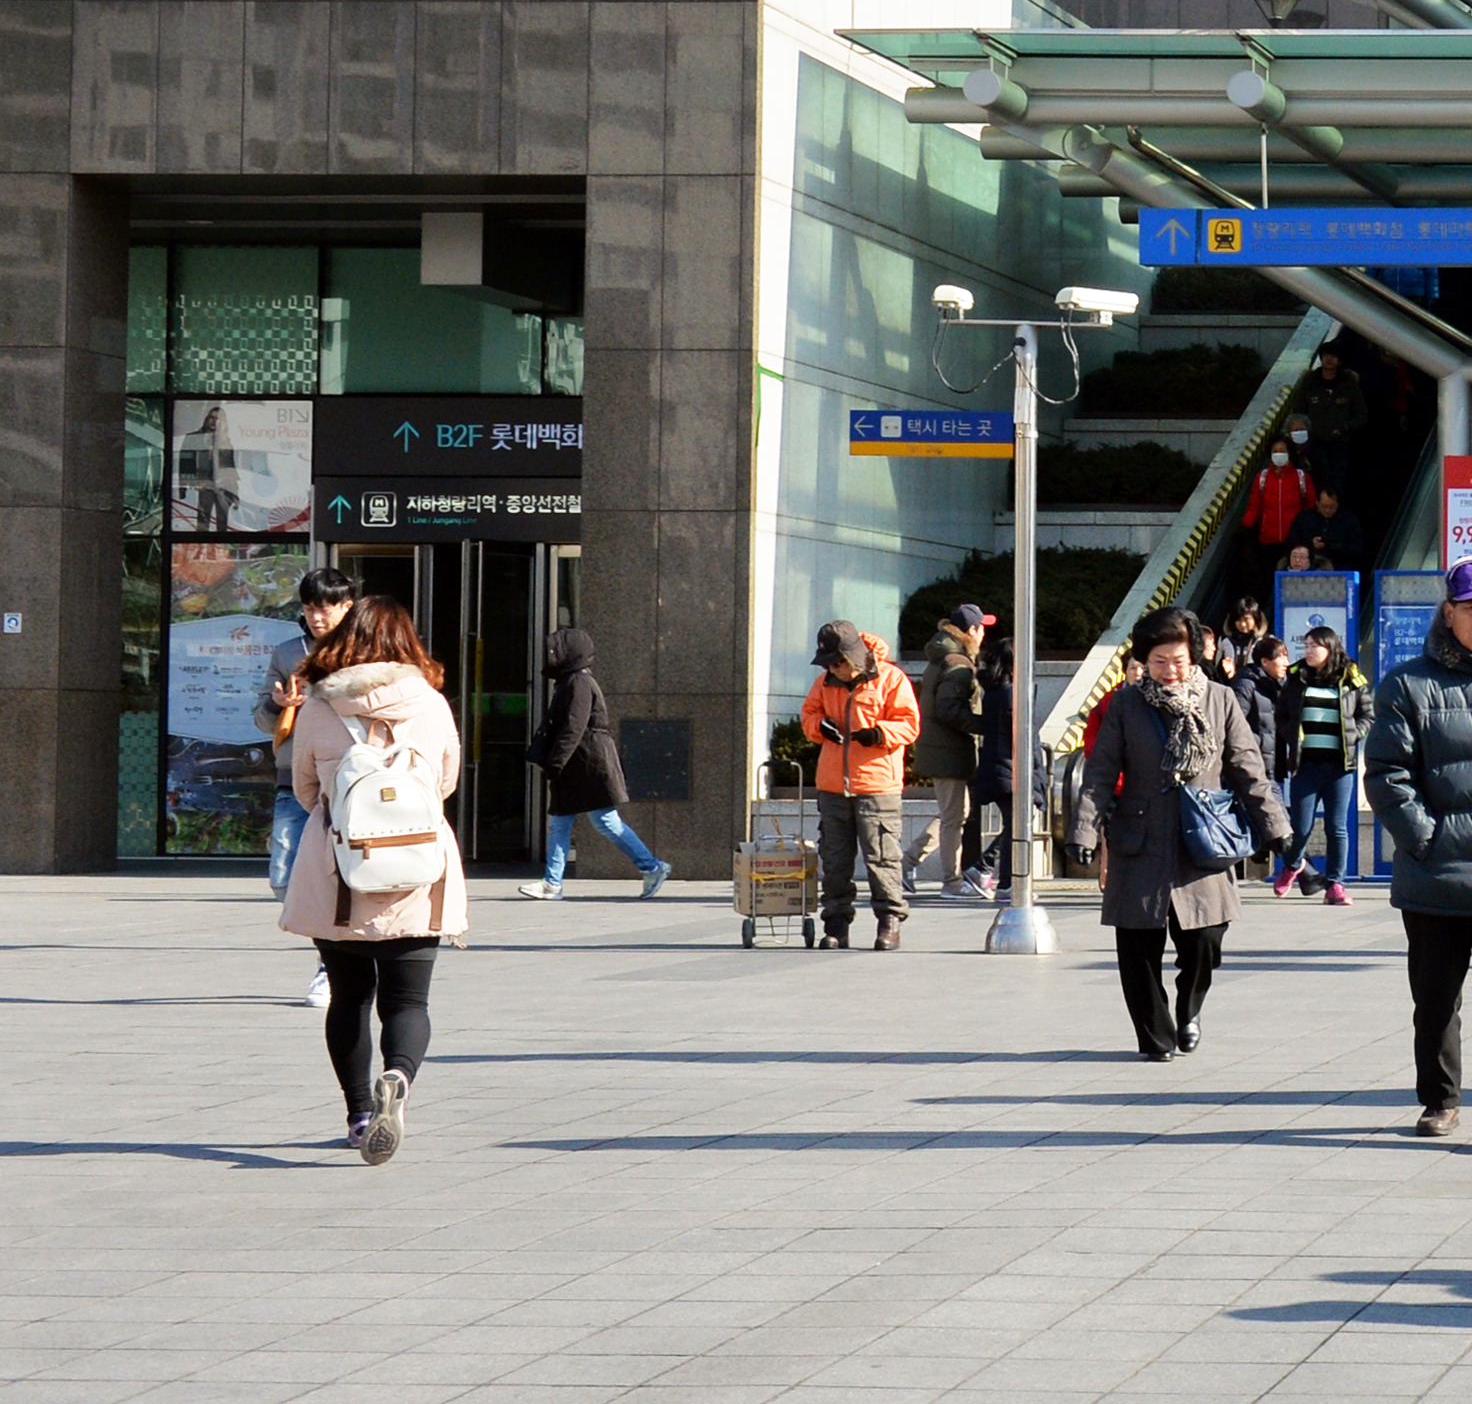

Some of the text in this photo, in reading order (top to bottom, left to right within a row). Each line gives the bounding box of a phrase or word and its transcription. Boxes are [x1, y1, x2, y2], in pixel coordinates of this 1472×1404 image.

[238, 425, 309, 440] Young Plaza
[436, 424, 484, 448] B2F
[907, 418, 993, 437] 택시 타는 곳
